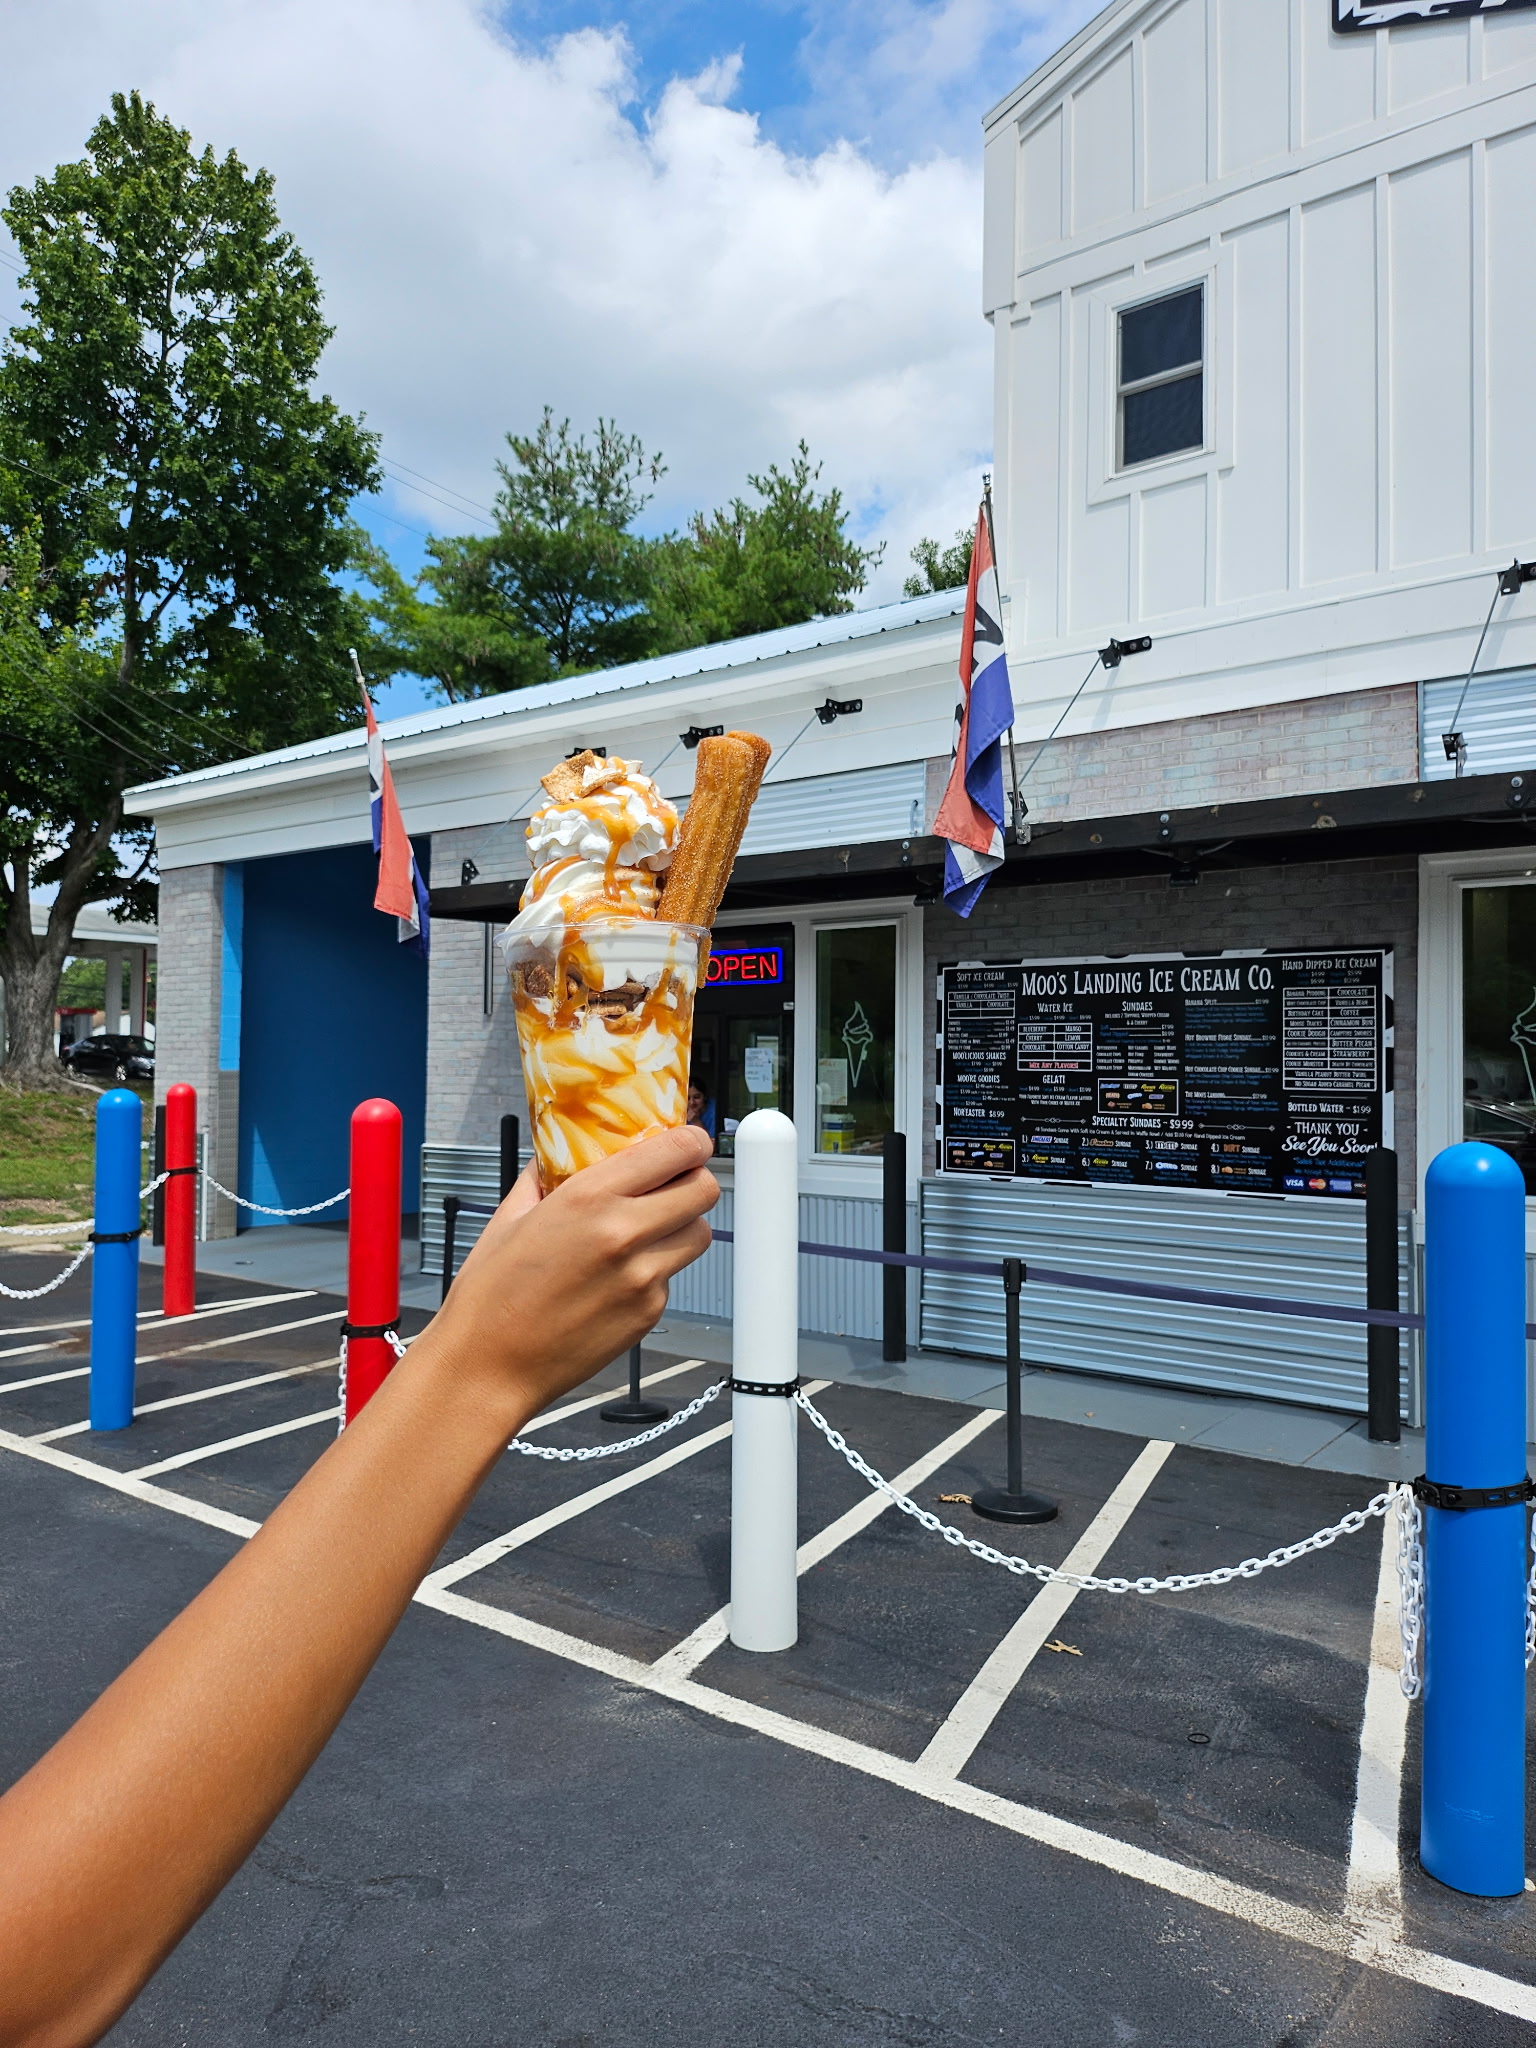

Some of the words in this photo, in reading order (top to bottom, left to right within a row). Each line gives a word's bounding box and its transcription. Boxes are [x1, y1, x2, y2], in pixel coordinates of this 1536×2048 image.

[706, 954, 776, 981] OPEN
[1282, 960, 1304, 970] HAND
[1306, 959, 1332, 970] DIPPED
[1334, 958, 1346, 969] ICE
[1349, 958, 1376, 968] CREAM
[956, 972, 971, 982] SOFT
[983, 972, 1005, 981] CREAM
[1022, 971, 1068, 996] MOO'S
[1073, 970, 1142, 995] LANDING
[1148, 968, 1174, 993] ICE
[1180, 967, 1241, 992] CREAM
[1248, 965, 1275, 991] CO.
[1336, 988, 1368, 996] CHOCOLATE
[1037, 1002, 1060, 1013] WATER
[1062, 1002, 1073, 1013] ICE
[1122, 1001, 1153, 1012] SUNDAES
[1340, 1008, 1360, 1016] COFFEE
[1330, 1018, 1360, 1026] CINNAMON
[1332, 1040, 1354, 1048] BUTTER
[1354, 1040, 1373, 1048] PECAN
[986, 1052, 1007, 1060] SHAKES
[1332, 1050, 1370, 1058] STRAWBERRY
[978, 1074, 1000, 1084] GOODIES
[1042, 1074, 1066, 1084] GELATI
[1288, 1102, 1318, 1112] BOTTLED
[1318, 1102, 1344, 1113] WATER
[1092, 1116, 1128, 1127] SPECIALTY
[1130, 1116, 1162, 1128] SUNDAES
[1294, 1122, 1332, 1135] THANK
[1335, 1123, 1360, 1136] YOU
[1224, 1144, 1240, 1152] DIRT
[1282, 1135, 1307, 1152] See
[1306, 1136, 1338, 1156] You
